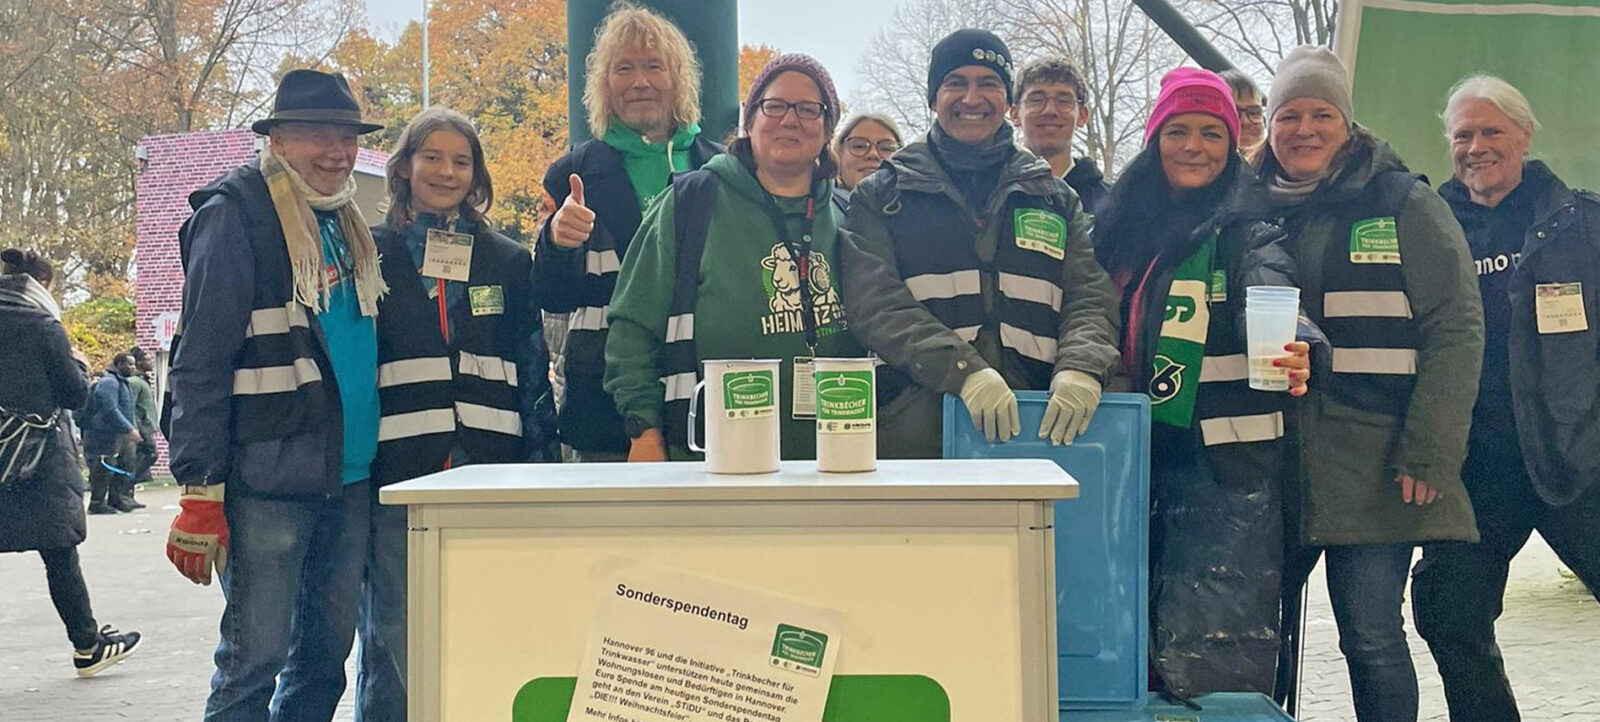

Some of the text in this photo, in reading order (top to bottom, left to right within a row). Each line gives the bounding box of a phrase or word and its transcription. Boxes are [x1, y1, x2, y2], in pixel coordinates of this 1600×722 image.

[821, 398, 866, 410] TRINKBECHER
[615, 583, 749, 630] Sonderspendentag
[598, 657, 665, 682] Wohnungslosen
[666, 677, 684, 686] und
[684, 680, 733, 699] Bedürftigen
[735, 693, 744, 702] in
[603, 636, 643, 653] Hannover
[645, 647, 656, 657] 96
[656, 652, 674, 661] und
[674, 655, 688, 665] die
[689, 658, 725, 674] Initiative
[782, 682, 795, 692] für
[656, 662, 709, 681] unterstützen
[710, 675, 734, 688] heute
[735, 683, 784, 701] gemeinsam
[785, 695, 799, 705] die
[585, 706, 607, 719] Mehr
[592, 680, 612, 691] geht
[612, 685, 624, 694] an
[625, 688, 641, 698] den
[643, 691, 669, 705] Verein
[707, 709, 724, 720] und
[595, 668, 782, 722] Eure Spende am heutigen Sonderspendentag
